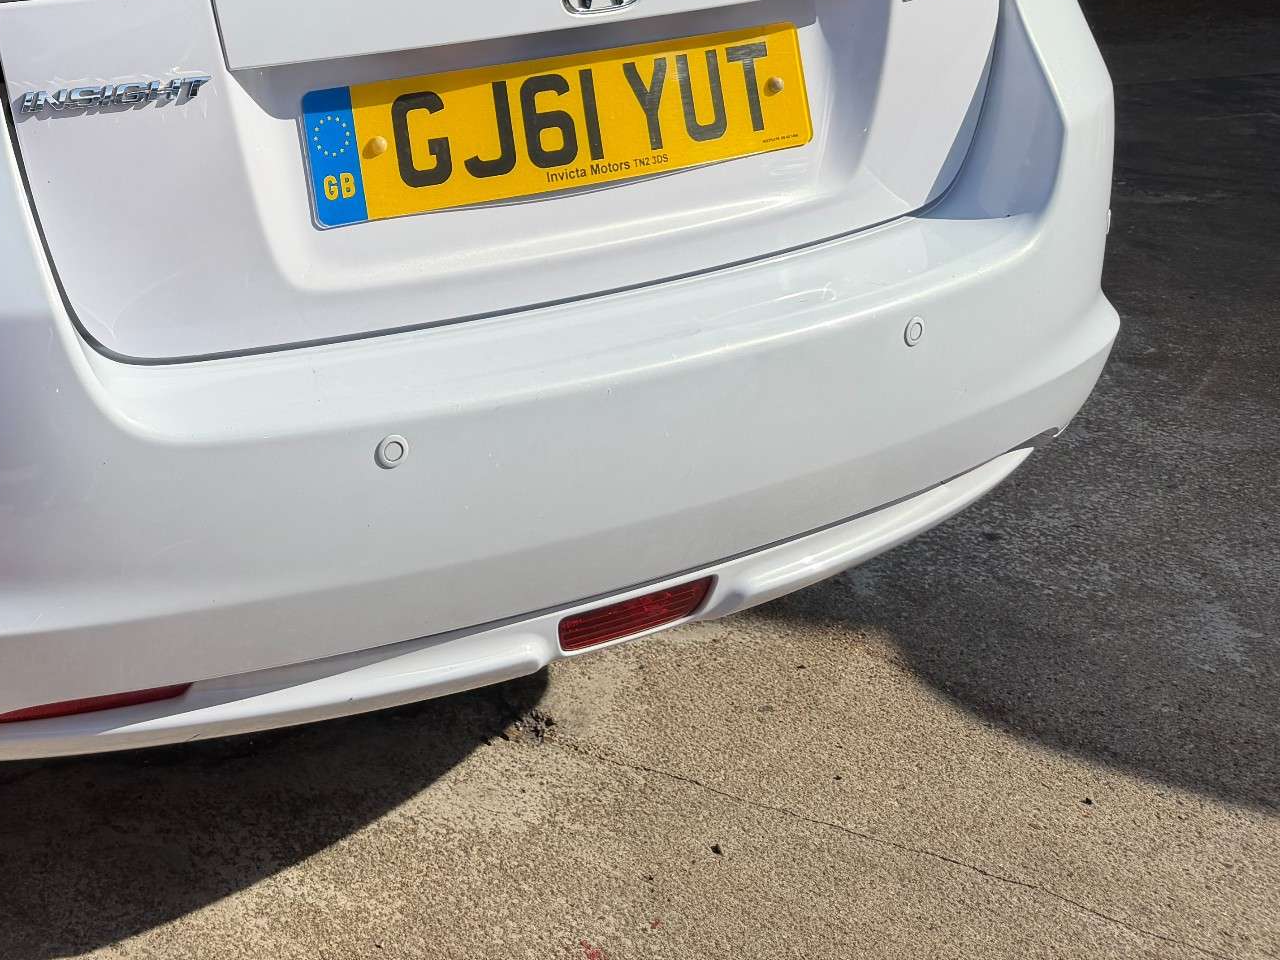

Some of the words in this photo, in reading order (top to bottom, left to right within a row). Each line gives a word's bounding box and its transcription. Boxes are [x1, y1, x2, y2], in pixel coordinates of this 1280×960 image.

[21, 74, 212, 114] INSIGHT
[390, 67, 605, 189] GJ61
[622, 40, 768, 151] YUT
[546, 167, 587, 183] Invicta
[590, 160, 631, 176] Motors
[633, 156, 650, 168] TN2
[651, 153, 669, 165] 3DS
[322, 172, 357, 202] GB
